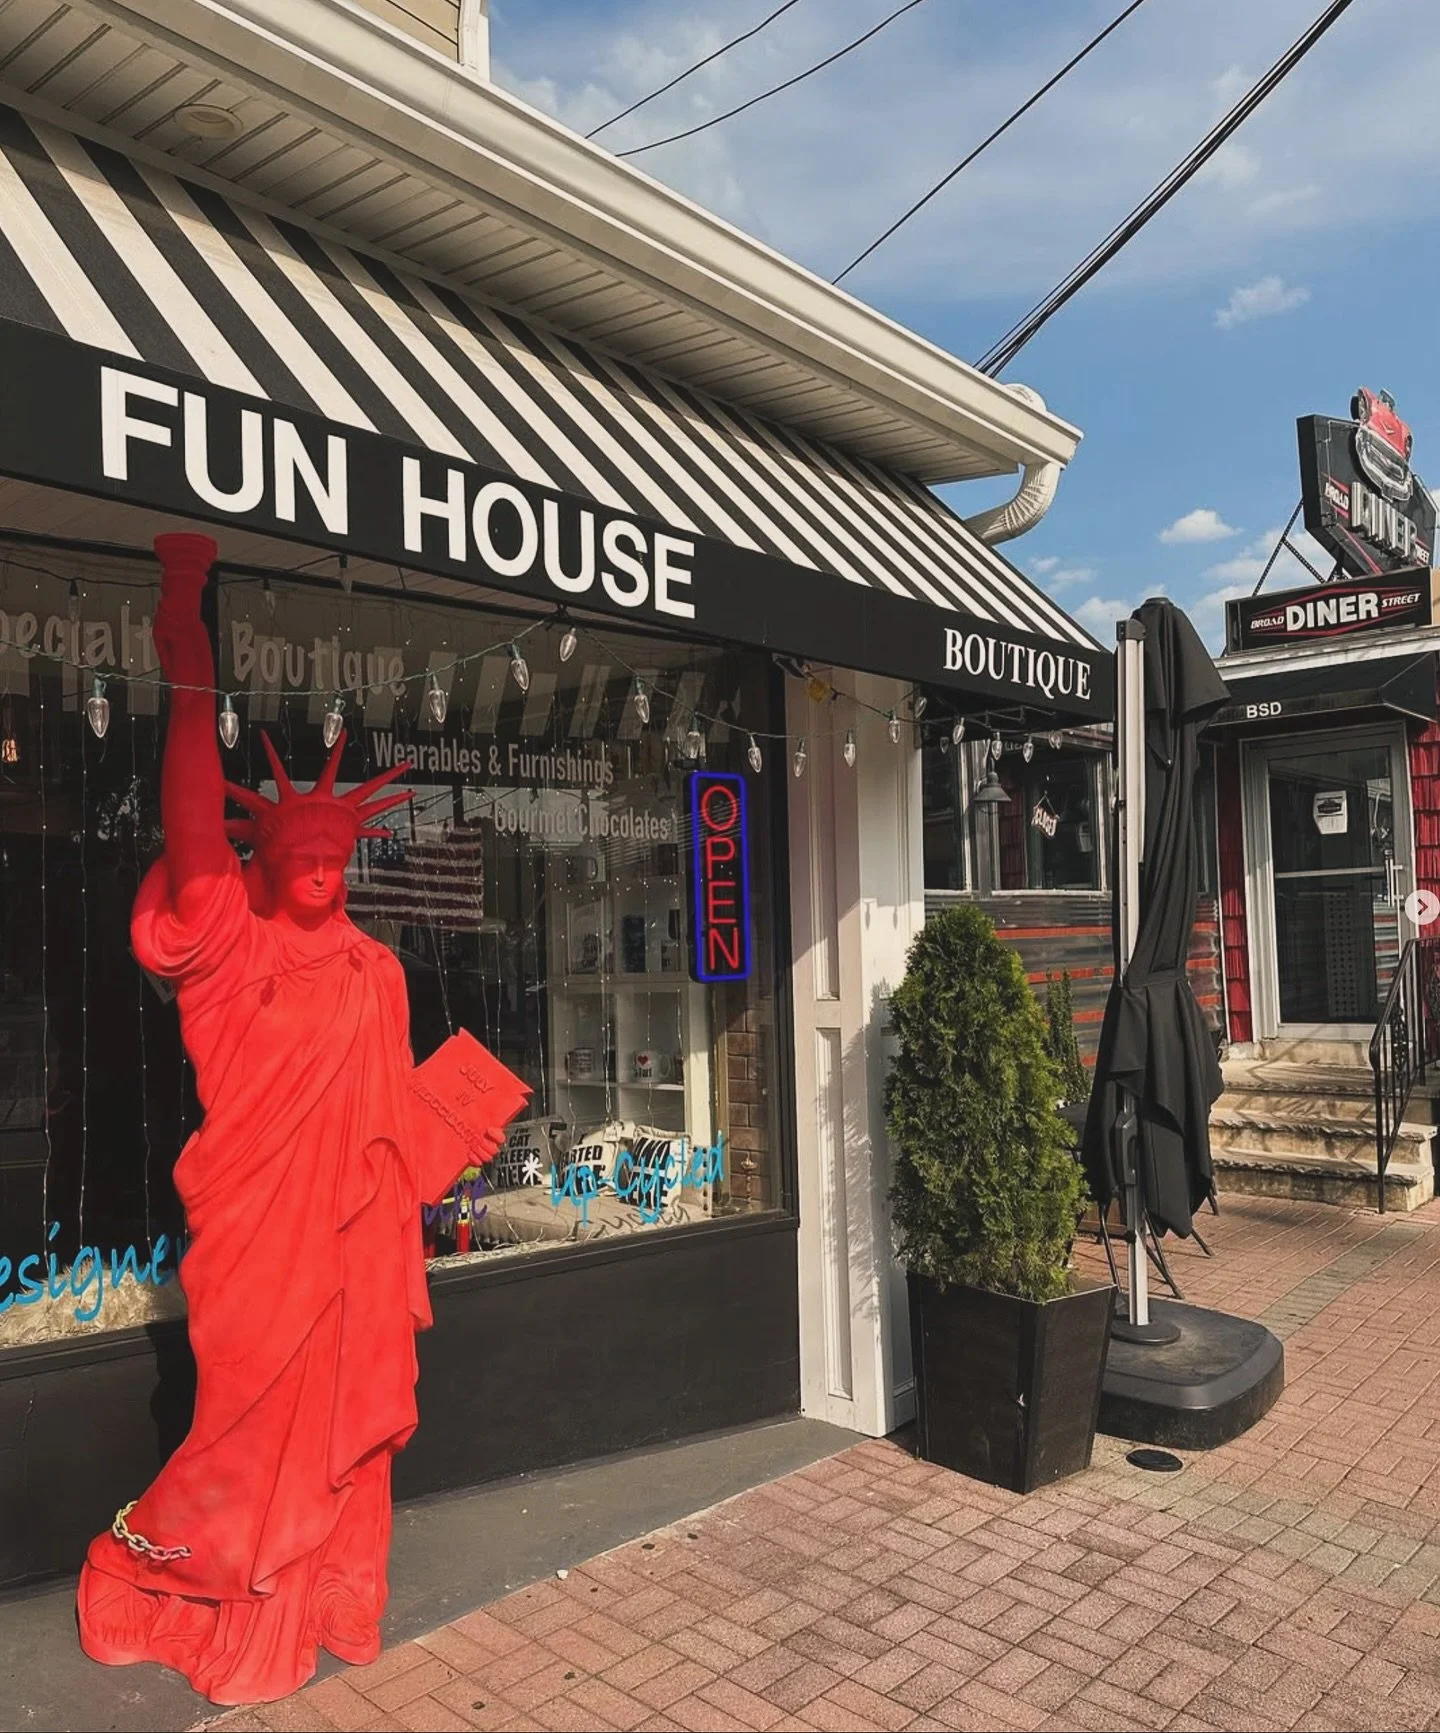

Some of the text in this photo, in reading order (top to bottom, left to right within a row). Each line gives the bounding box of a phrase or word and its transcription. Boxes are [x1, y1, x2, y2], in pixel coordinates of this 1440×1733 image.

[101, 366, 695, 619] FUN HOUSE
[1351, 482, 1418, 559] DINER
[1250, 592, 1421, 632] BROAD DINER STREET
[231, 619, 407, 706] Boutique
[943, 627, 1092, 700] BOUTIQUE
[1246, 701, 1282, 719] BSD
[373, 731, 614, 788] Wearables & Furnishings
[494, 800, 669, 841] Gourmet Chocolates
[701, 785, 740, 971] OPEN
[459, 1062, 494, 1094] JULY
[500, 1147, 540, 1164] SLEEPS
[509, 1133, 531, 1148] CAT
[0, 1221, 189, 1323] esigne
